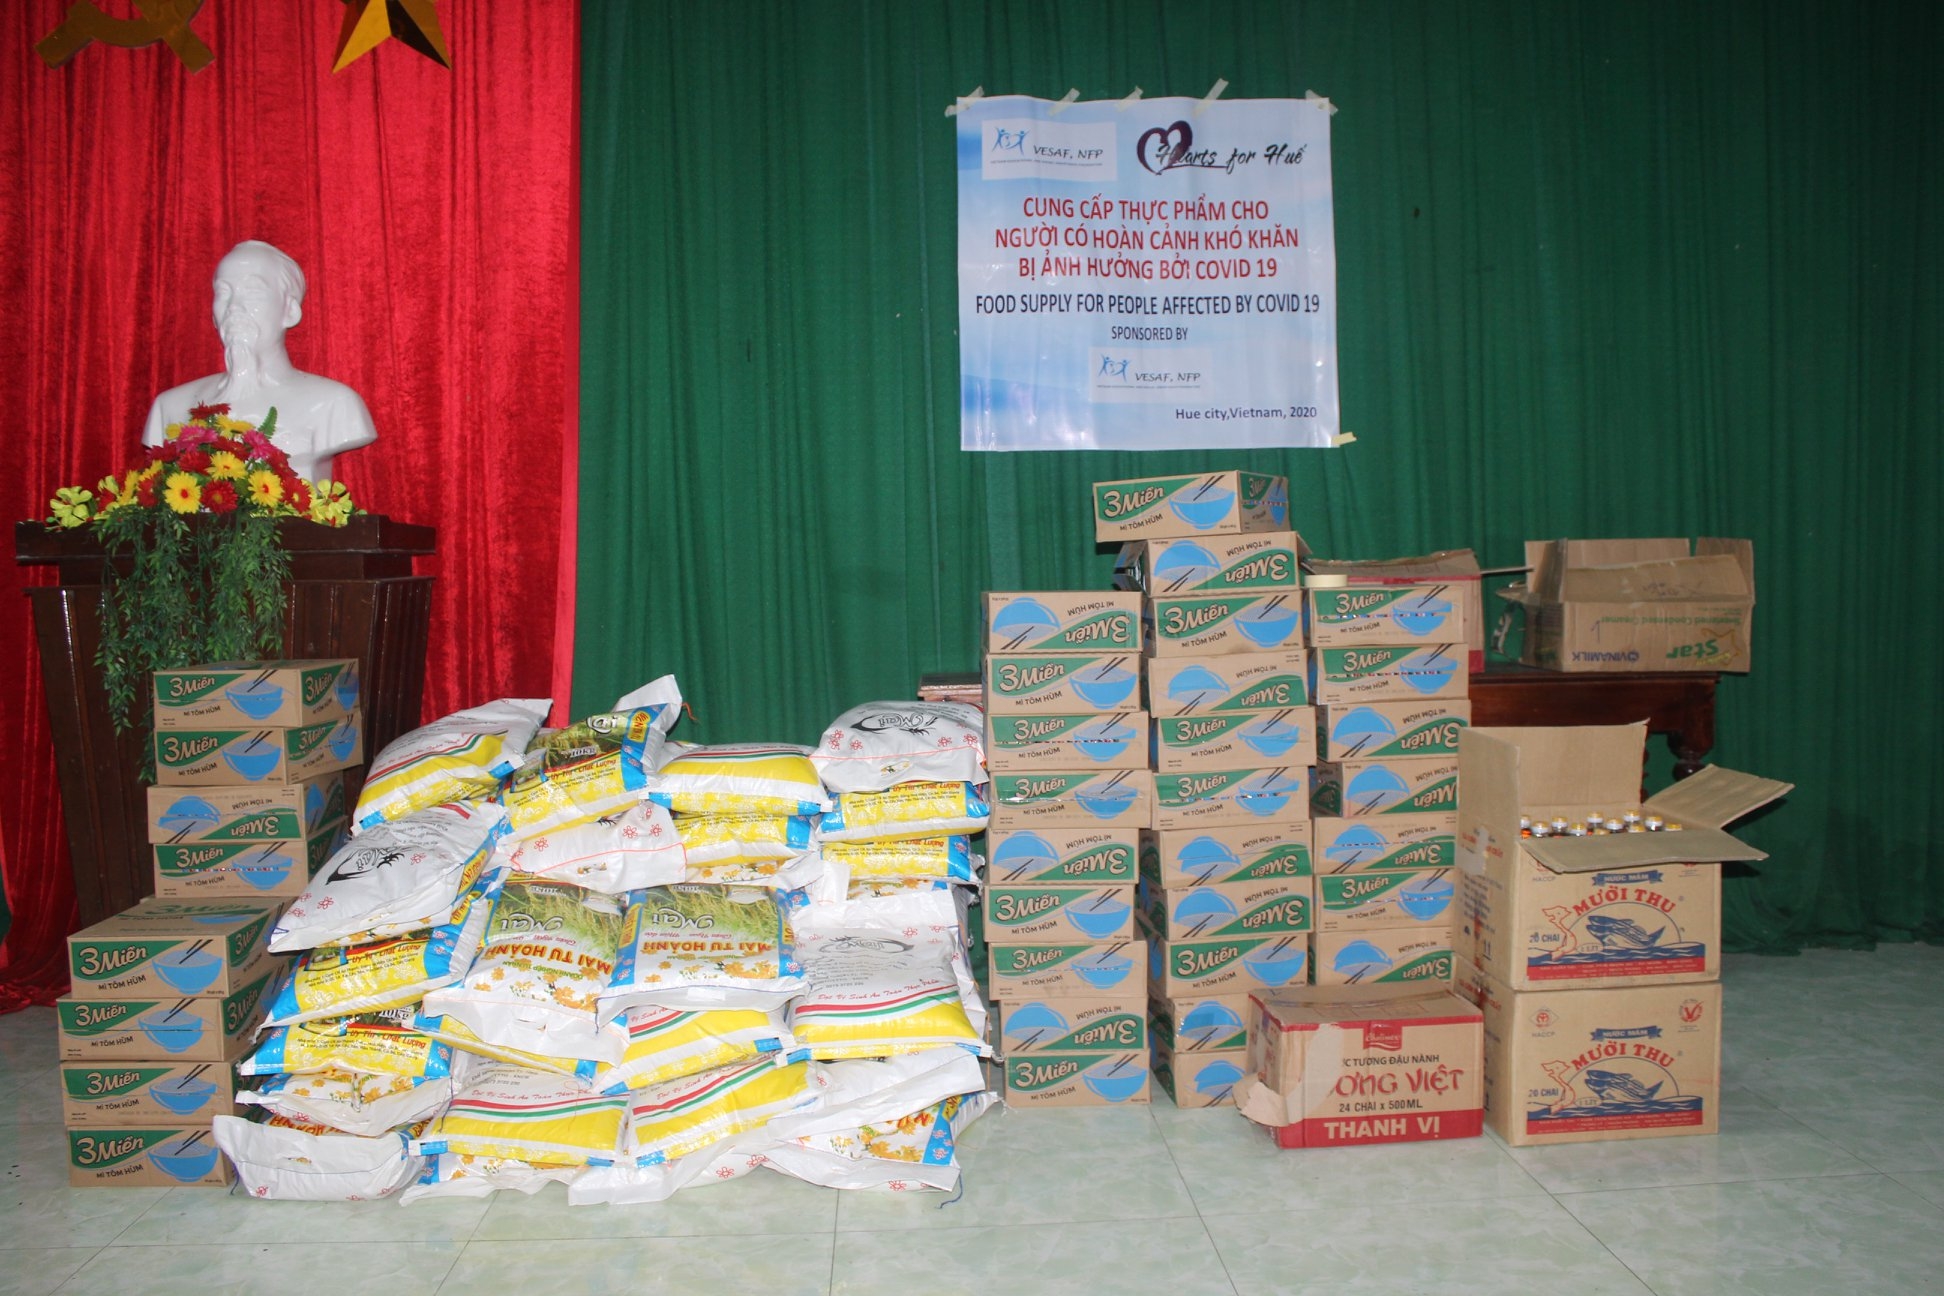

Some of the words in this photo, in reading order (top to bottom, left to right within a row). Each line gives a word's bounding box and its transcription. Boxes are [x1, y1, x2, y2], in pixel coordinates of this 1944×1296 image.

[1077, 149, 1104, 160] NFP
[1226, 147, 1256, 174] for
[1264, 142, 1308, 165] Huế
[1023, 197, 1074, 218] CUNG
[1079, 193, 1114, 220] CẤP
[1119, 200, 1168, 225] THỰC
[1174, 193, 1226, 220] PHẨM
[1231, 200, 1269, 220] CHO
[995, 221, 1058, 248] NGƯỜI
[1064, 222, 1088, 247] CÓ
[1093, 224, 1144, 250] HOÀN
[1150, 223, 1199, 250] CẢNH
[1204, 224, 1242, 250] KHÓ
[1249, 223, 1299, 249] KHĂN
[1019, 257, 1035, 281] BỊ
[1041, 249, 1081, 277] ẢNH
[1087, 251, 1153, 280] HƯỞNG
[1160, 252, 1190, 280] BỞI
[1196, 258, 1250, 280] COVID
[1256, 257, 1277, 278] 19
[976, 295, 1016, 314] FOOD
[1020, 294, 1072, 313] SUPPLY
[1077, 293, 1105, 313] FOR
[1109, 295, 1158, 315] PEOPLE
[1162, 295, 1231, 315] AFFECTED
[1236, 295, 1252, 313] BY
[1256, 293, 1300, 313] COVID
[1304, 294, 1320, 313] 19
[1111, 325, 1173, 341] SPONSORED
[1176, 327, 1188, 341] BY
[1177, 372, 1201, 382] NFP
[1175, 408, 1201, 420] Hue
[1290, 406, 1317, 418] 2020
[1666, 639, 1719, 659] Star
[1572, 652, 1630, 663] VINAMILK
[1634, 888, 1676, 914] THU
[1541, 934, 1560, 943] CHAI
[738, 942, 771, 954] MAI
[578, 954, 613, 975] MAI
[107, 979, 126, 990] TÔM
[1388, 1055, 1410, 1068] ĐẬU
[1411, 1053, 1440, 1064] NÀNH
[1633, 1043, 1676, 1068] THU
[1405, 1064, 1464, 1097] VIỆT
[1528, 1089, 1539, 1098] 20
[1540, 1089, 1559, 1097] CHAI
[1339, 1103, 1350, 1113] 24
[1354, 1101, 1377, 1112] CHAI
[1388, 1099, 1423, 1110] 500ML
[1324, 1117, 1407, 1140] THANH
[1416, 1116, 1440, 1139] VỊ
[106, 1168, 124, 1178] TÔM
